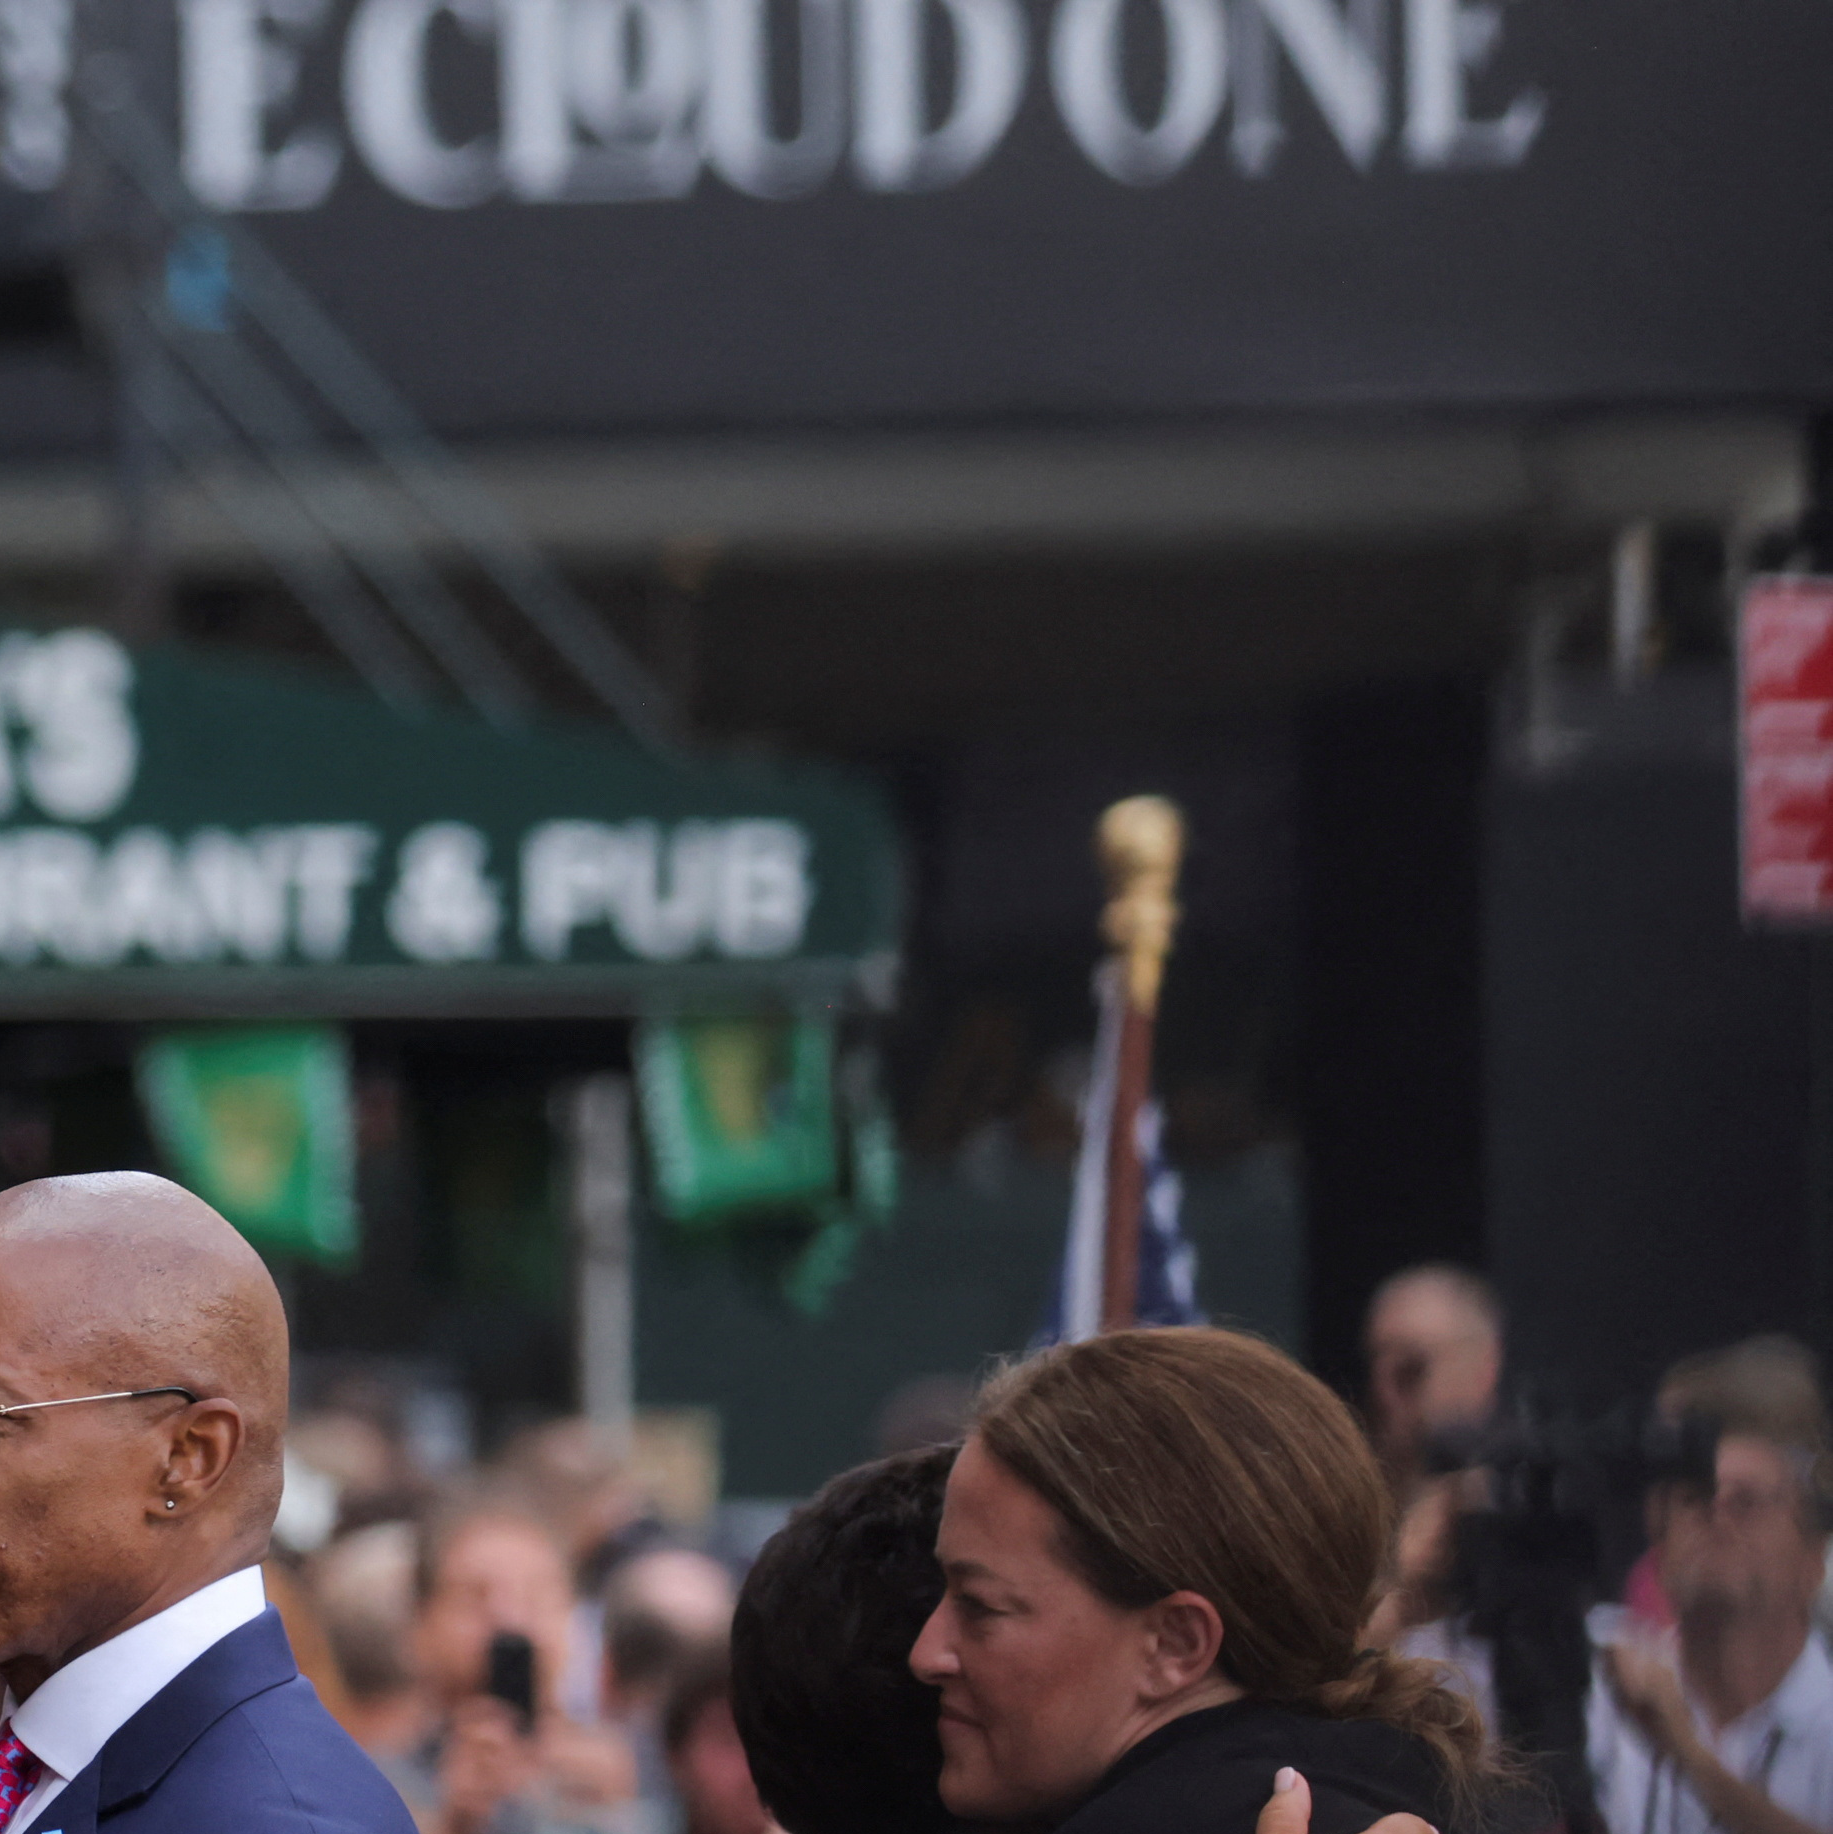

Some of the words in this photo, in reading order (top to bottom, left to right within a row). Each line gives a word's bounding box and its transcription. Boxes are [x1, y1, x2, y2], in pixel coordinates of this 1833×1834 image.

[1047, 0, 1545, 187] ONE
[383, 818, 501, 962] &
[518, 816, 813, 962] PUB
